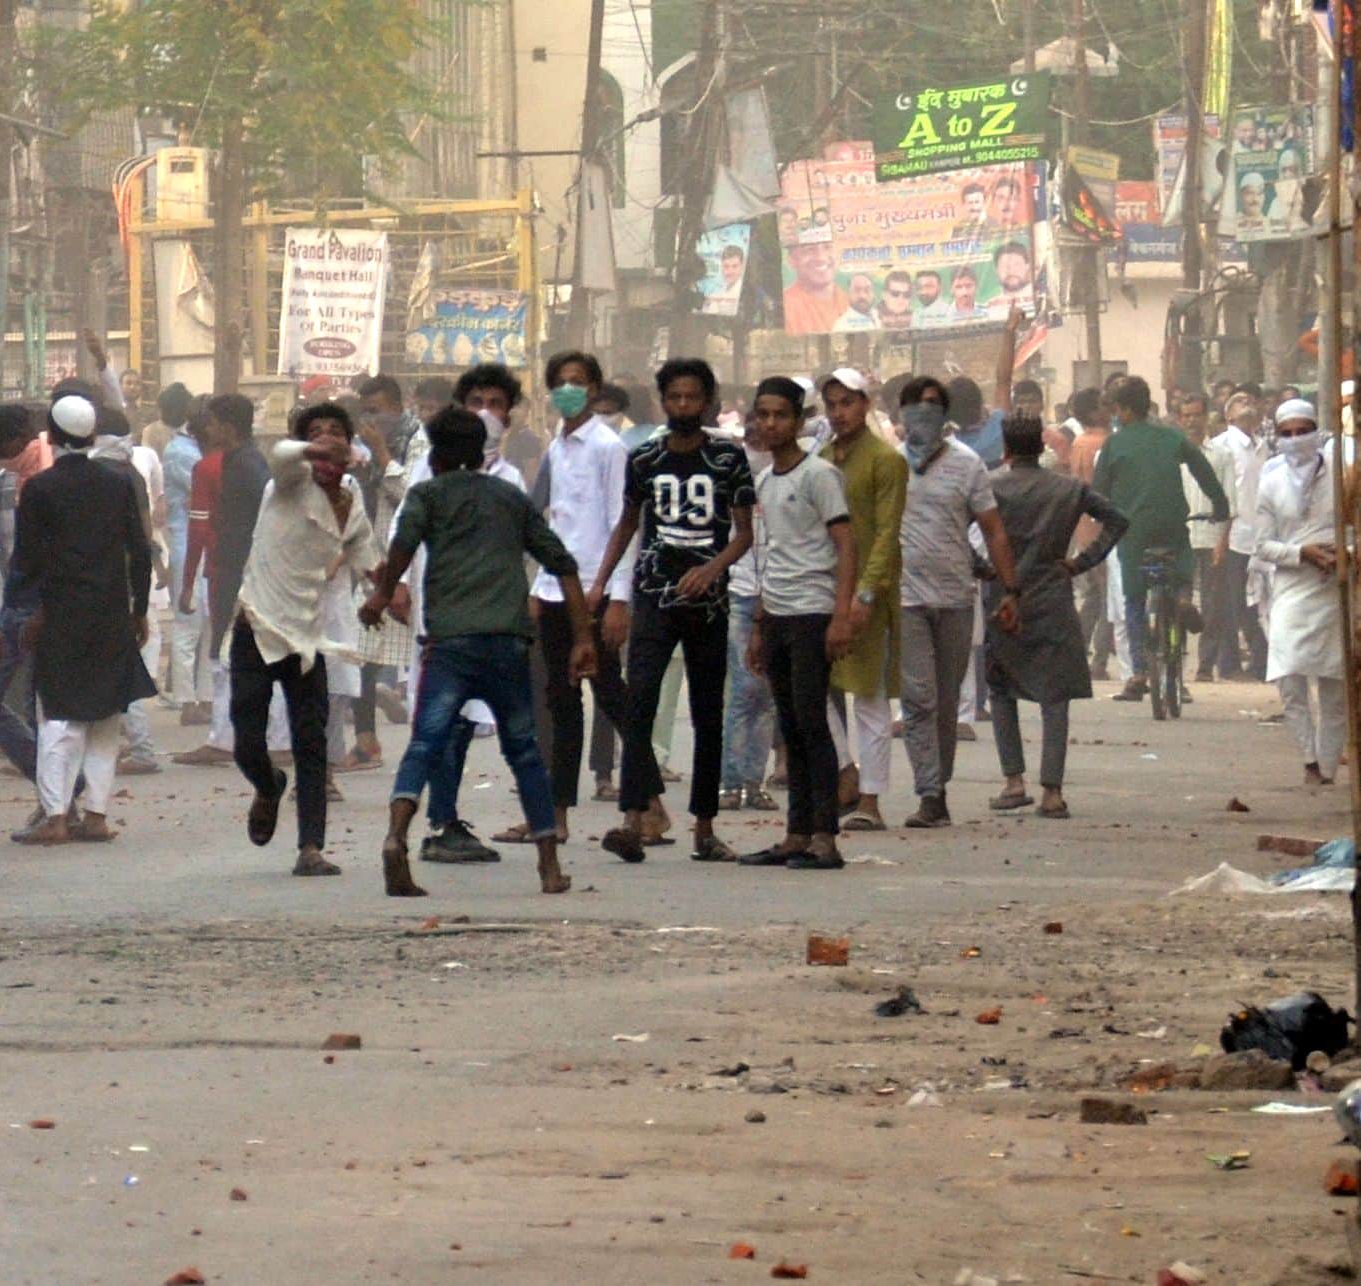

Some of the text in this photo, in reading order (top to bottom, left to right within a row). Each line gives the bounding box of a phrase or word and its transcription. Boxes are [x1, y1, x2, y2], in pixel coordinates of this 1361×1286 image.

[917, 84, 1007, 111] ईद मुबारक
[898, 102, 1018, 148] A to Z
[907, 137, 1004, 159] SHOPPING MALL
[288, 239, 325, 260] Grand
[294, 267, 373, 284] Banquet Hall
[288, 304, 376, 322] For All Types
[319, 321, 362, 334] Parties
[654, 474, 714, 525] 09
